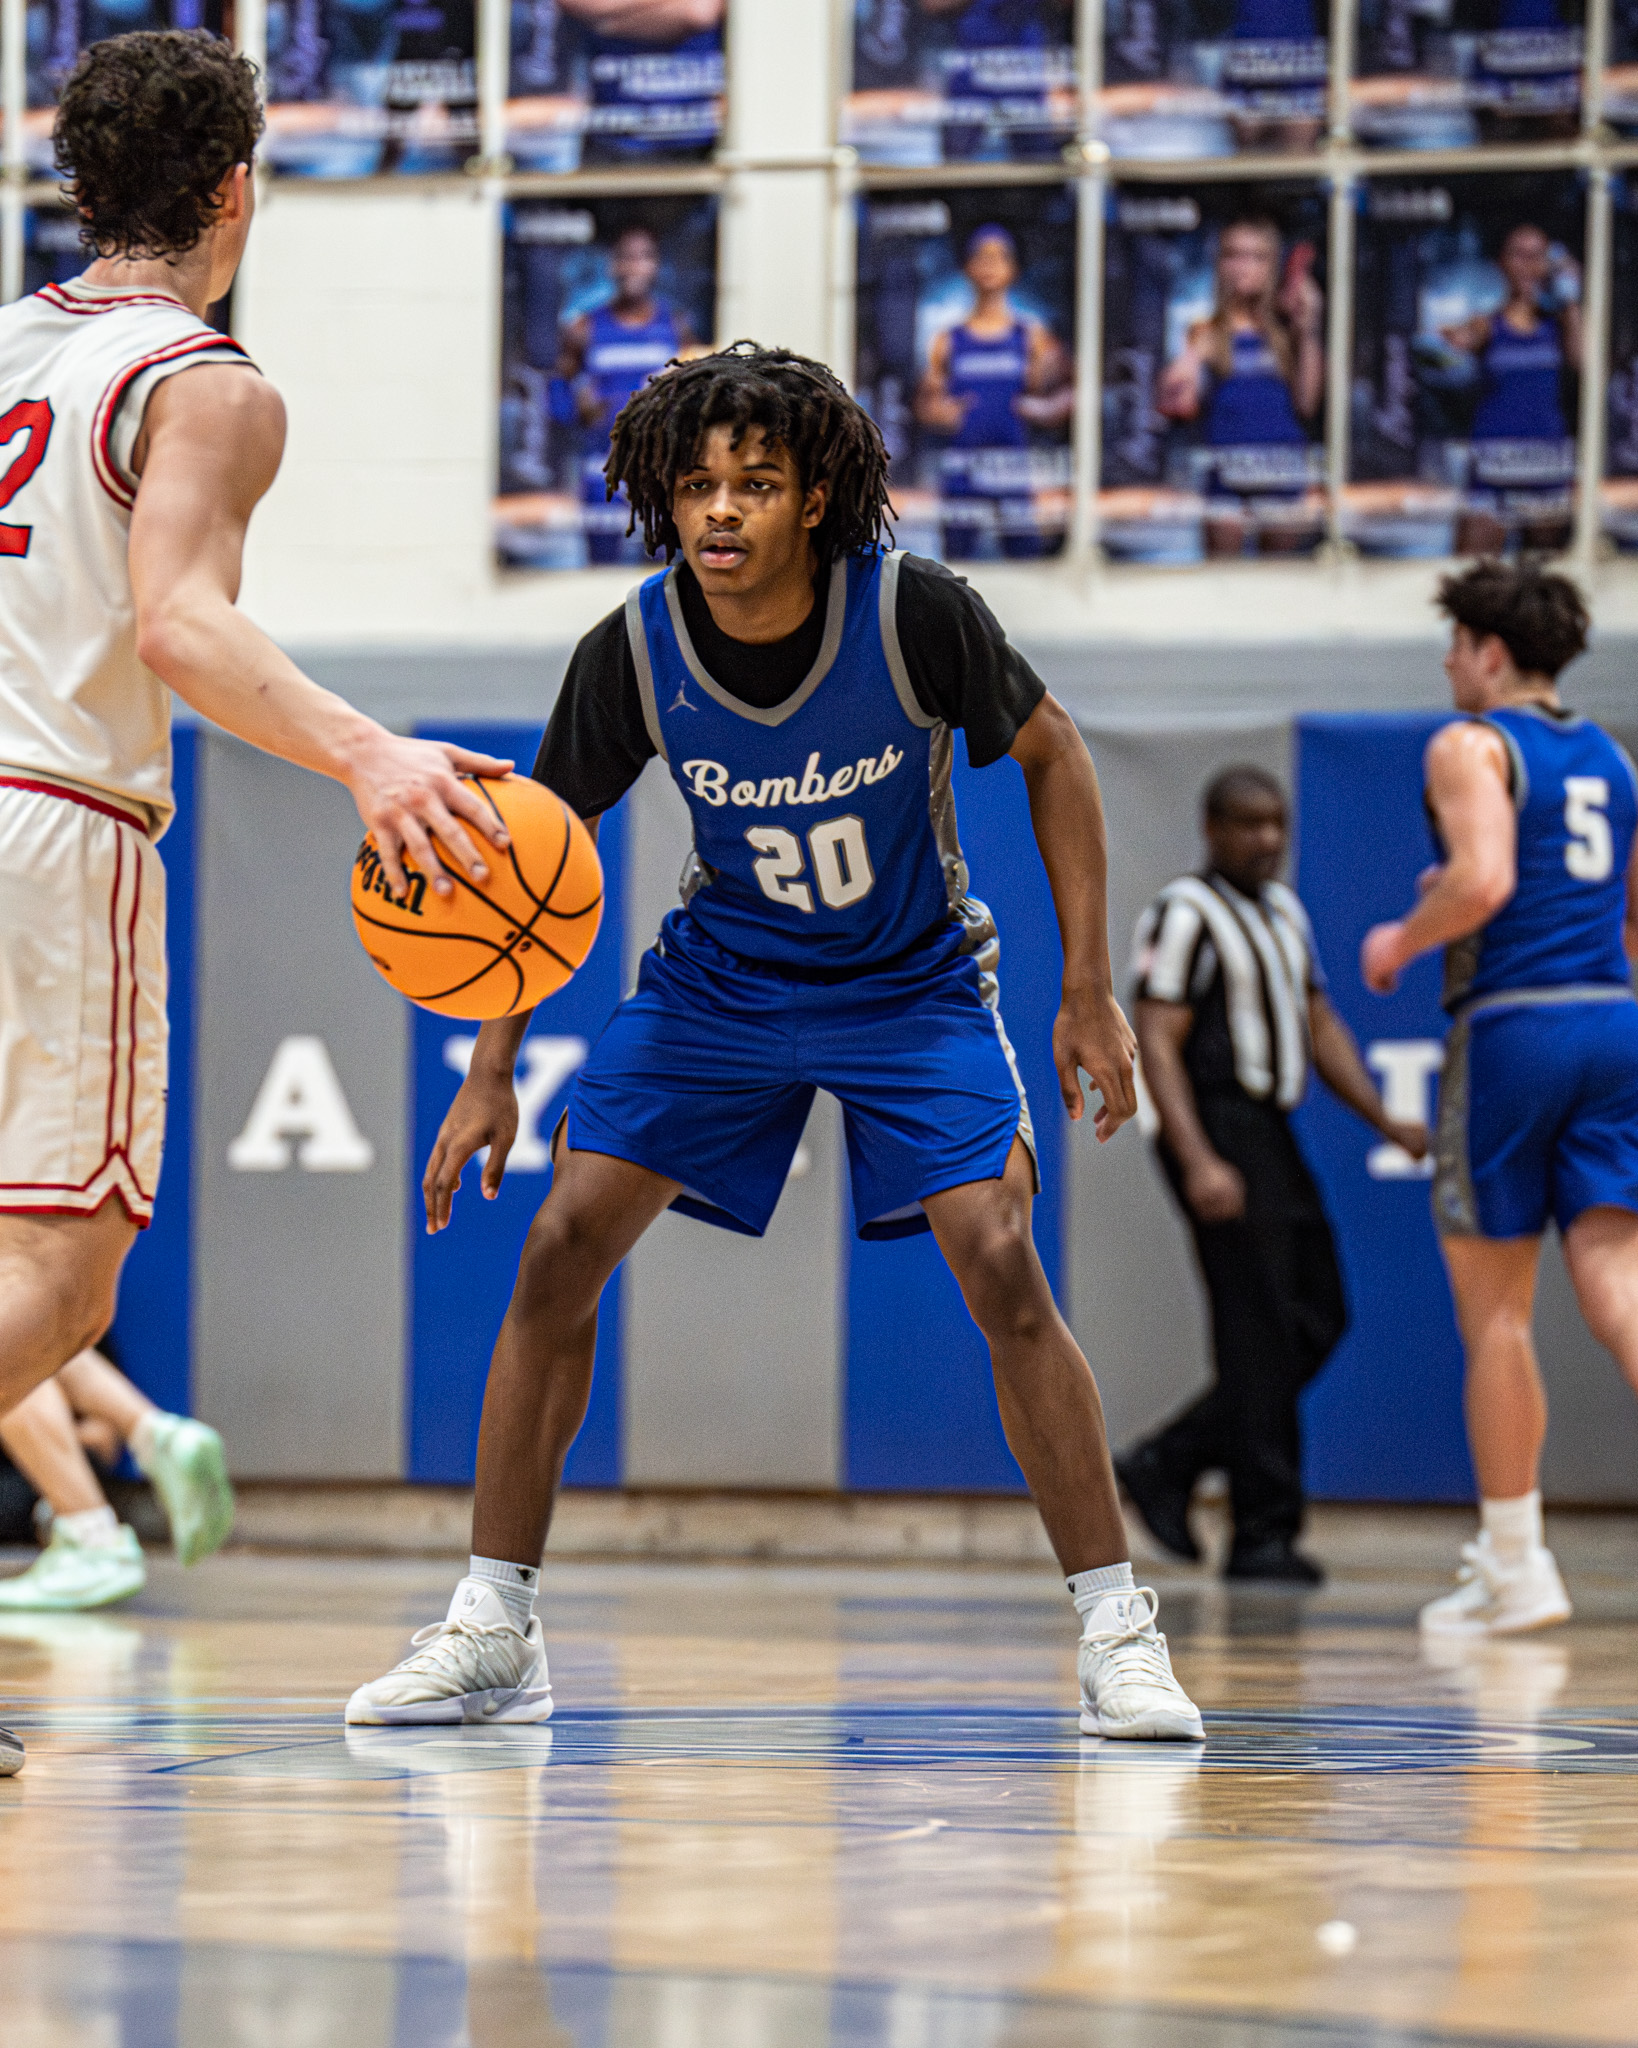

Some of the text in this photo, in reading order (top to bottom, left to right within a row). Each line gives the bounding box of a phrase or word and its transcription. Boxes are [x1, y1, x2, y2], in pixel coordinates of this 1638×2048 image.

[0, 396, 55, 559] 2
[682, 744, 904, 808] Bombers
[743, 813, 876, 914] 20
[1563, 776, 1614, 881] 5
